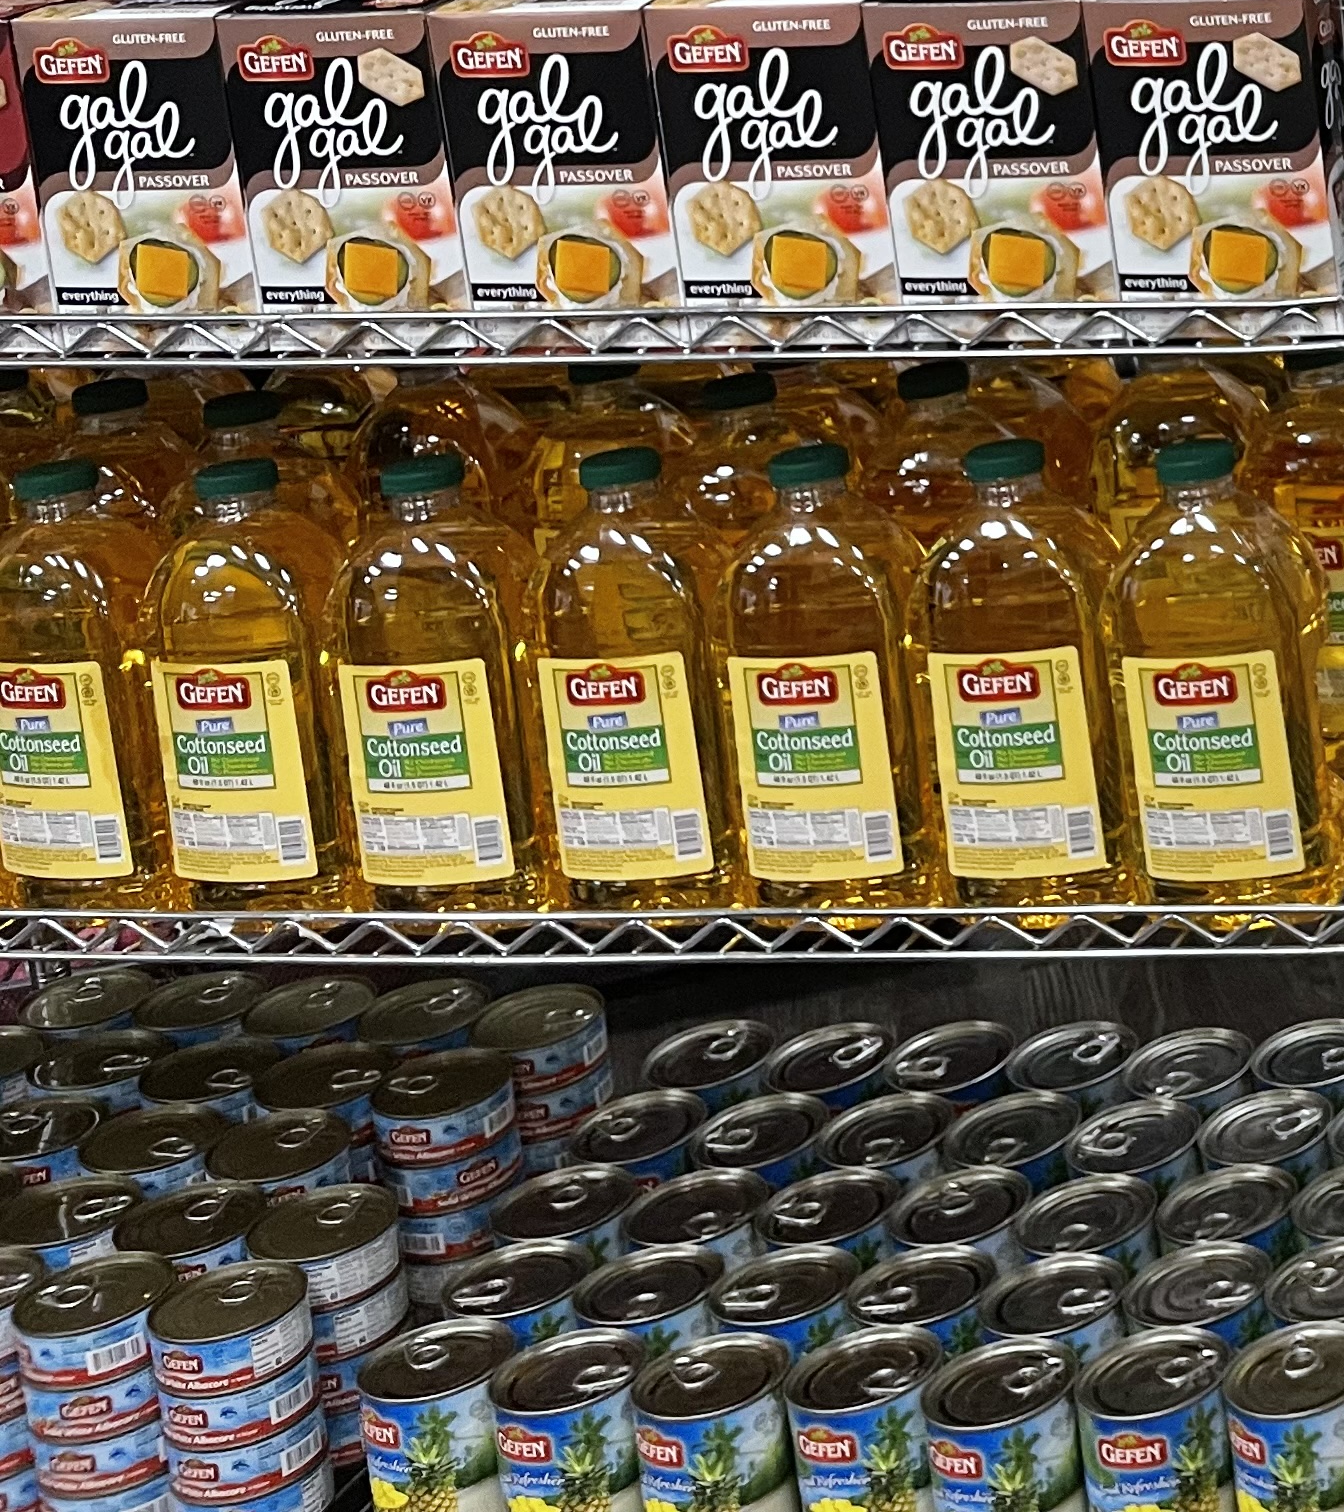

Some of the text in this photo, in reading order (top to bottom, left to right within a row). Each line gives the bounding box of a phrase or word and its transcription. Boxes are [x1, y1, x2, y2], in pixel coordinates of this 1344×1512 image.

[1189, 13, 1272, 28] GLUTEN-FREE
[316, 28, 395, 42] GLUTEN-FREE
[1111, 36, 1179, 60] GEFEN
[243, 51, 307, 73] GEFEN
[1132, 41, 1239, 175] gal
[264, 57, 366, 191] gal
[1178, 84, 1279, 195] gal
[308, 99, 403, 207] gal
[1215, 157, 1293, 174] PASSOVER
[345, 170, 419, 186] PASSOVER
[1125, 276, 1188, 292] everything
[266, 290, 325, 304] everything
[570, 677, 637, 700] GEFEN
[1158, 676, 1229, 700] GEFEN
[592, 715, 623, 730] Pure
[1182, 714, 1216, 729] Pure
[566, 729, 660, 751] Cottonseed
[1153, 728, 1253, 751] Cottonseed
[578, 754, 600, 772] Oil
[1167, 752, 1191, 772] Oil
[393, 1131, 428, 1145] GEFEN
[163, 1356, 200, 1372] GEFEN
[499, 1438, 545, 1460] GEFEN
[800, 1438, 850, 1459] GEFEN
[1101, 1443, 1164, 1464] GEFEN
